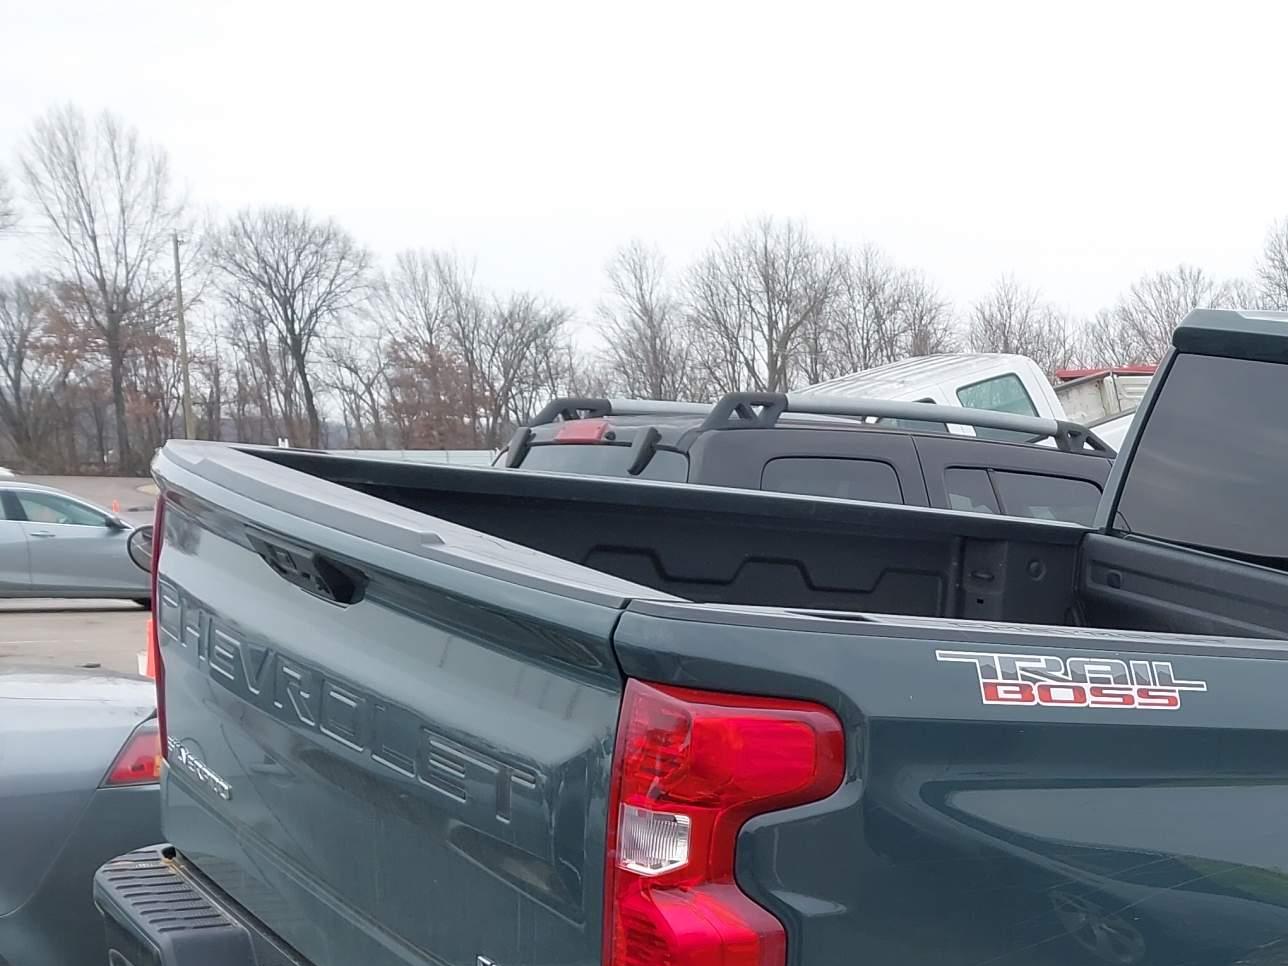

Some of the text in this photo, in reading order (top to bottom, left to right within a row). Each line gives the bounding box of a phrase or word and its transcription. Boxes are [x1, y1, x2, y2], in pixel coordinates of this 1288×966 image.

[936, 650, 1208, 691] TRAIL
[159, 573, 541, 823] CHEVROLET
[981, 681, 1181, 709] BOSS
